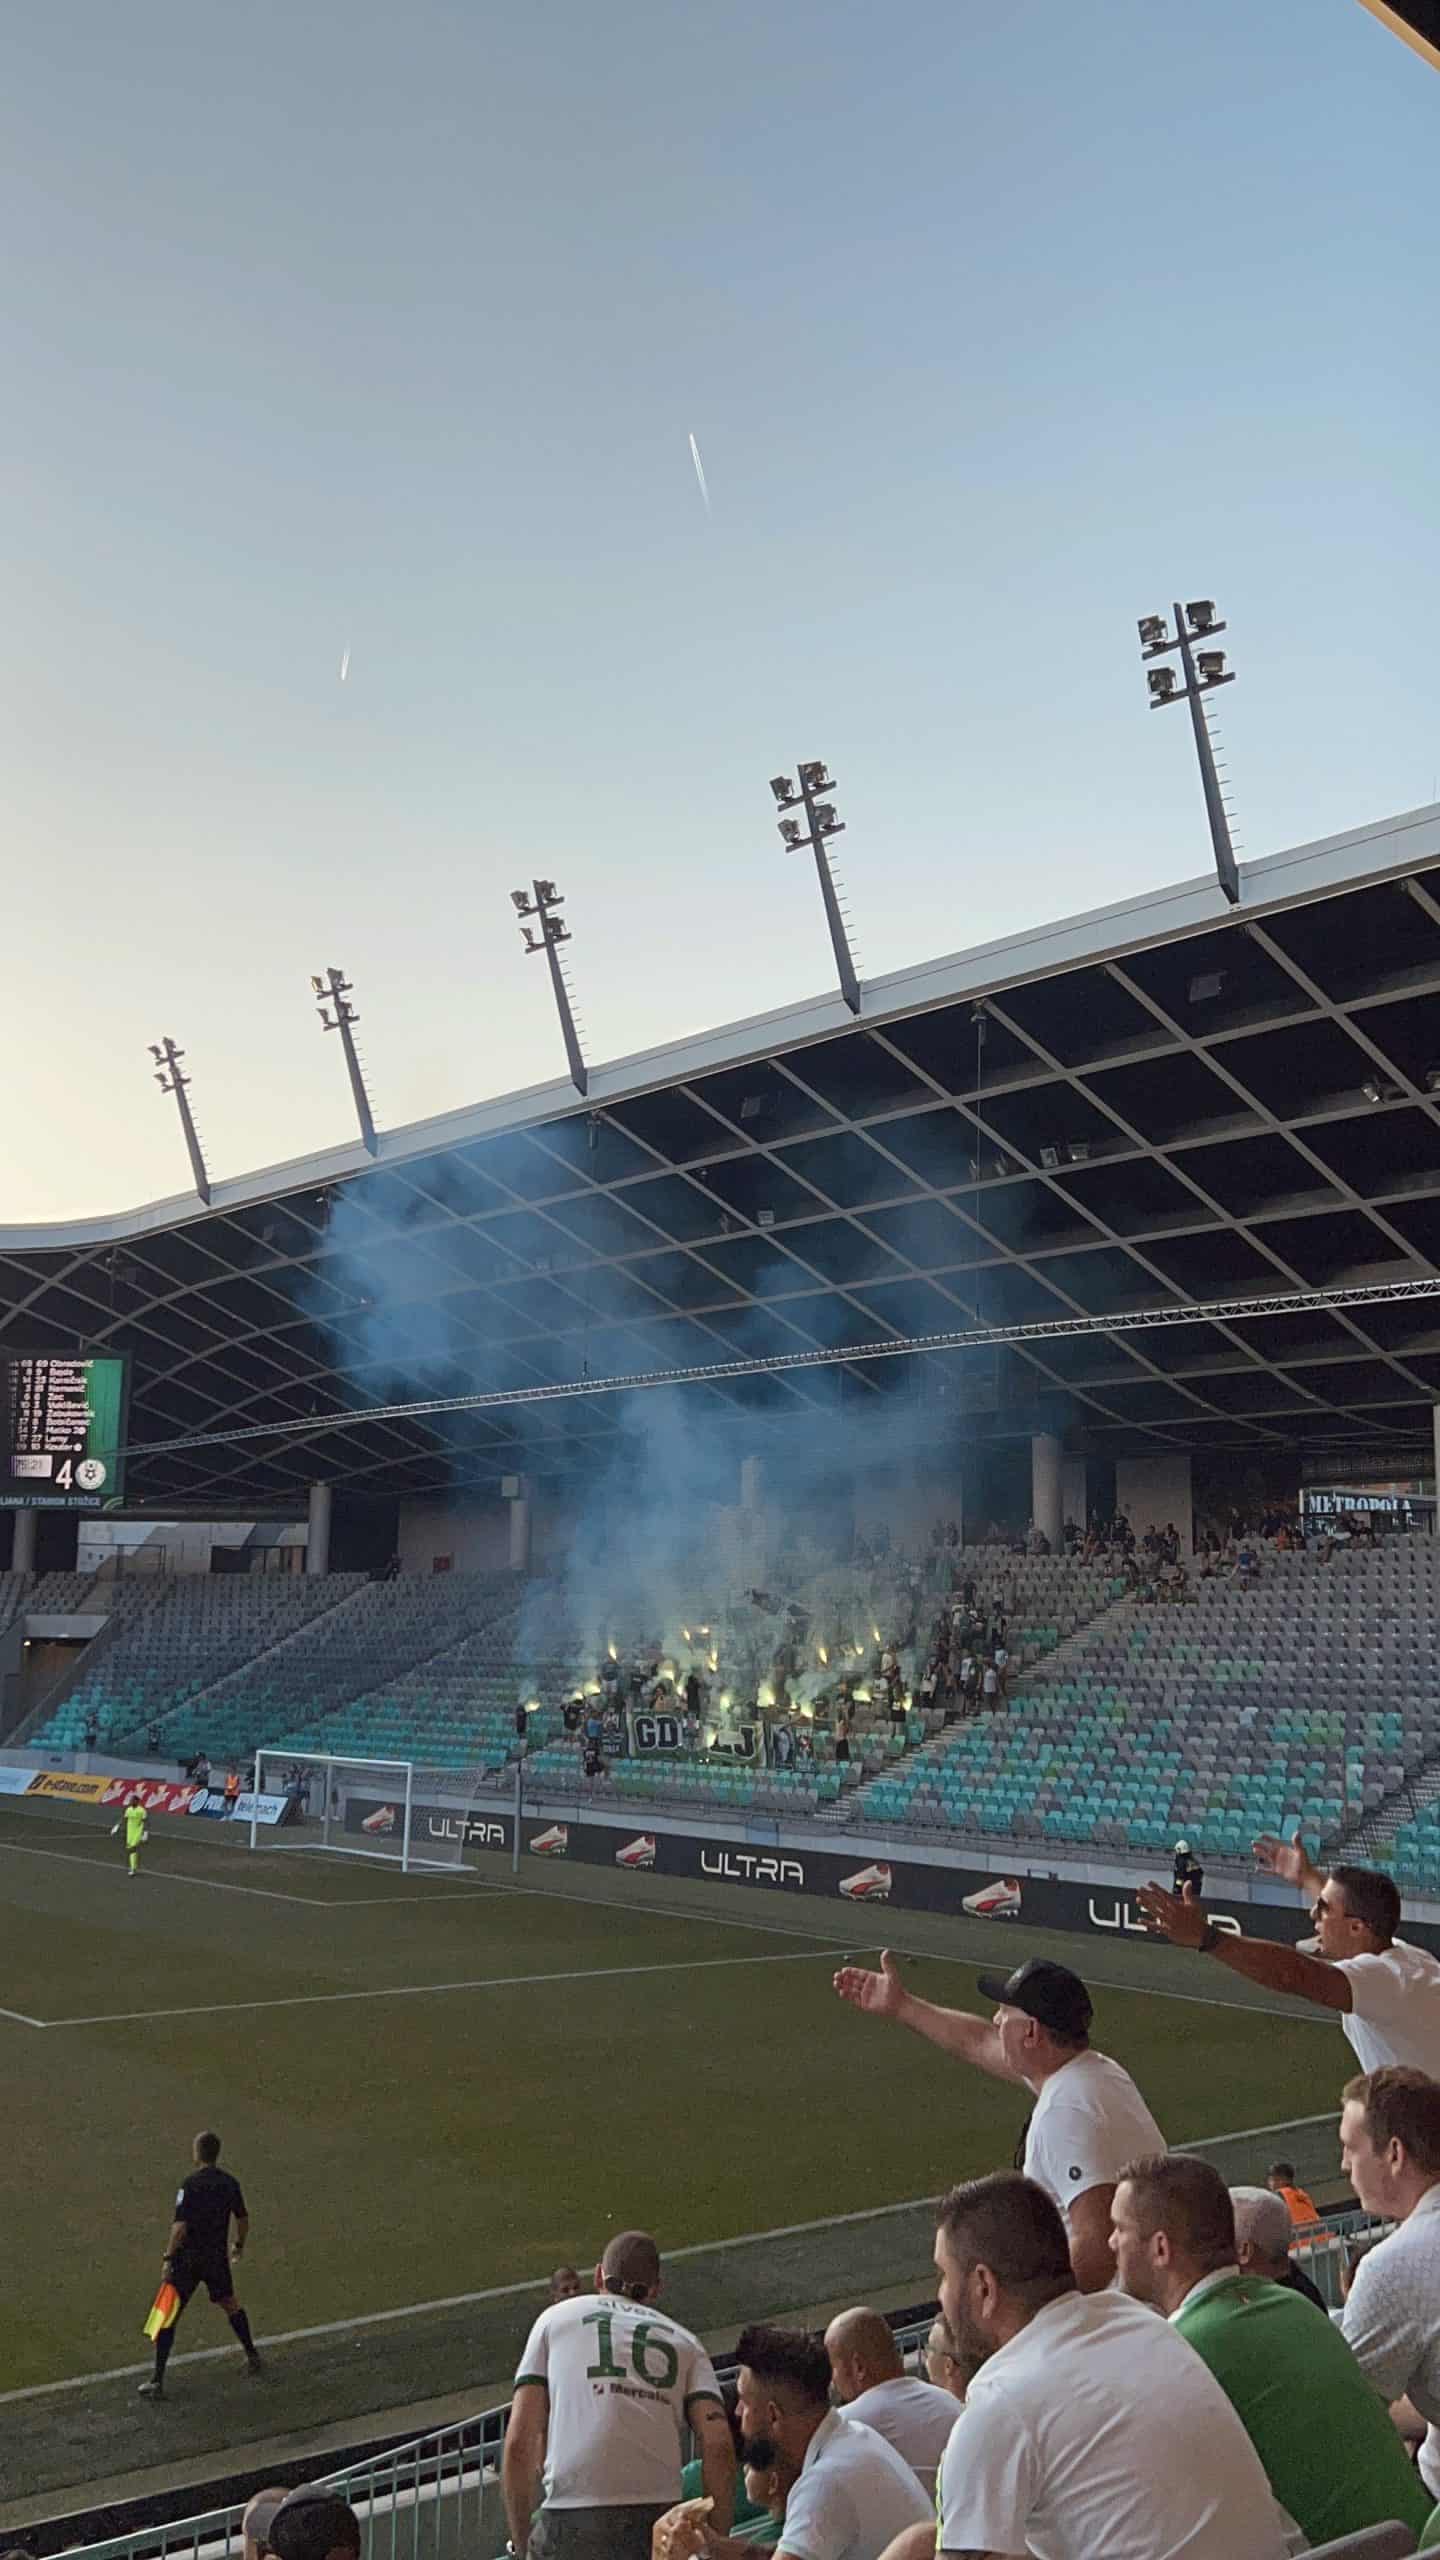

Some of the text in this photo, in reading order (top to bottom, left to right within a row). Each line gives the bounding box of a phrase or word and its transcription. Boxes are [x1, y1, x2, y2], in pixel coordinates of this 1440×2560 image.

[55, 1459, 73, 1490] 4
[428, 1816, 505, 1846] ULTRA
[700, 1849, 805, 1886] ULTRA
[1088, 1898, 1243, 1937] ULA
[582, 2311, 678, 2389] 16
